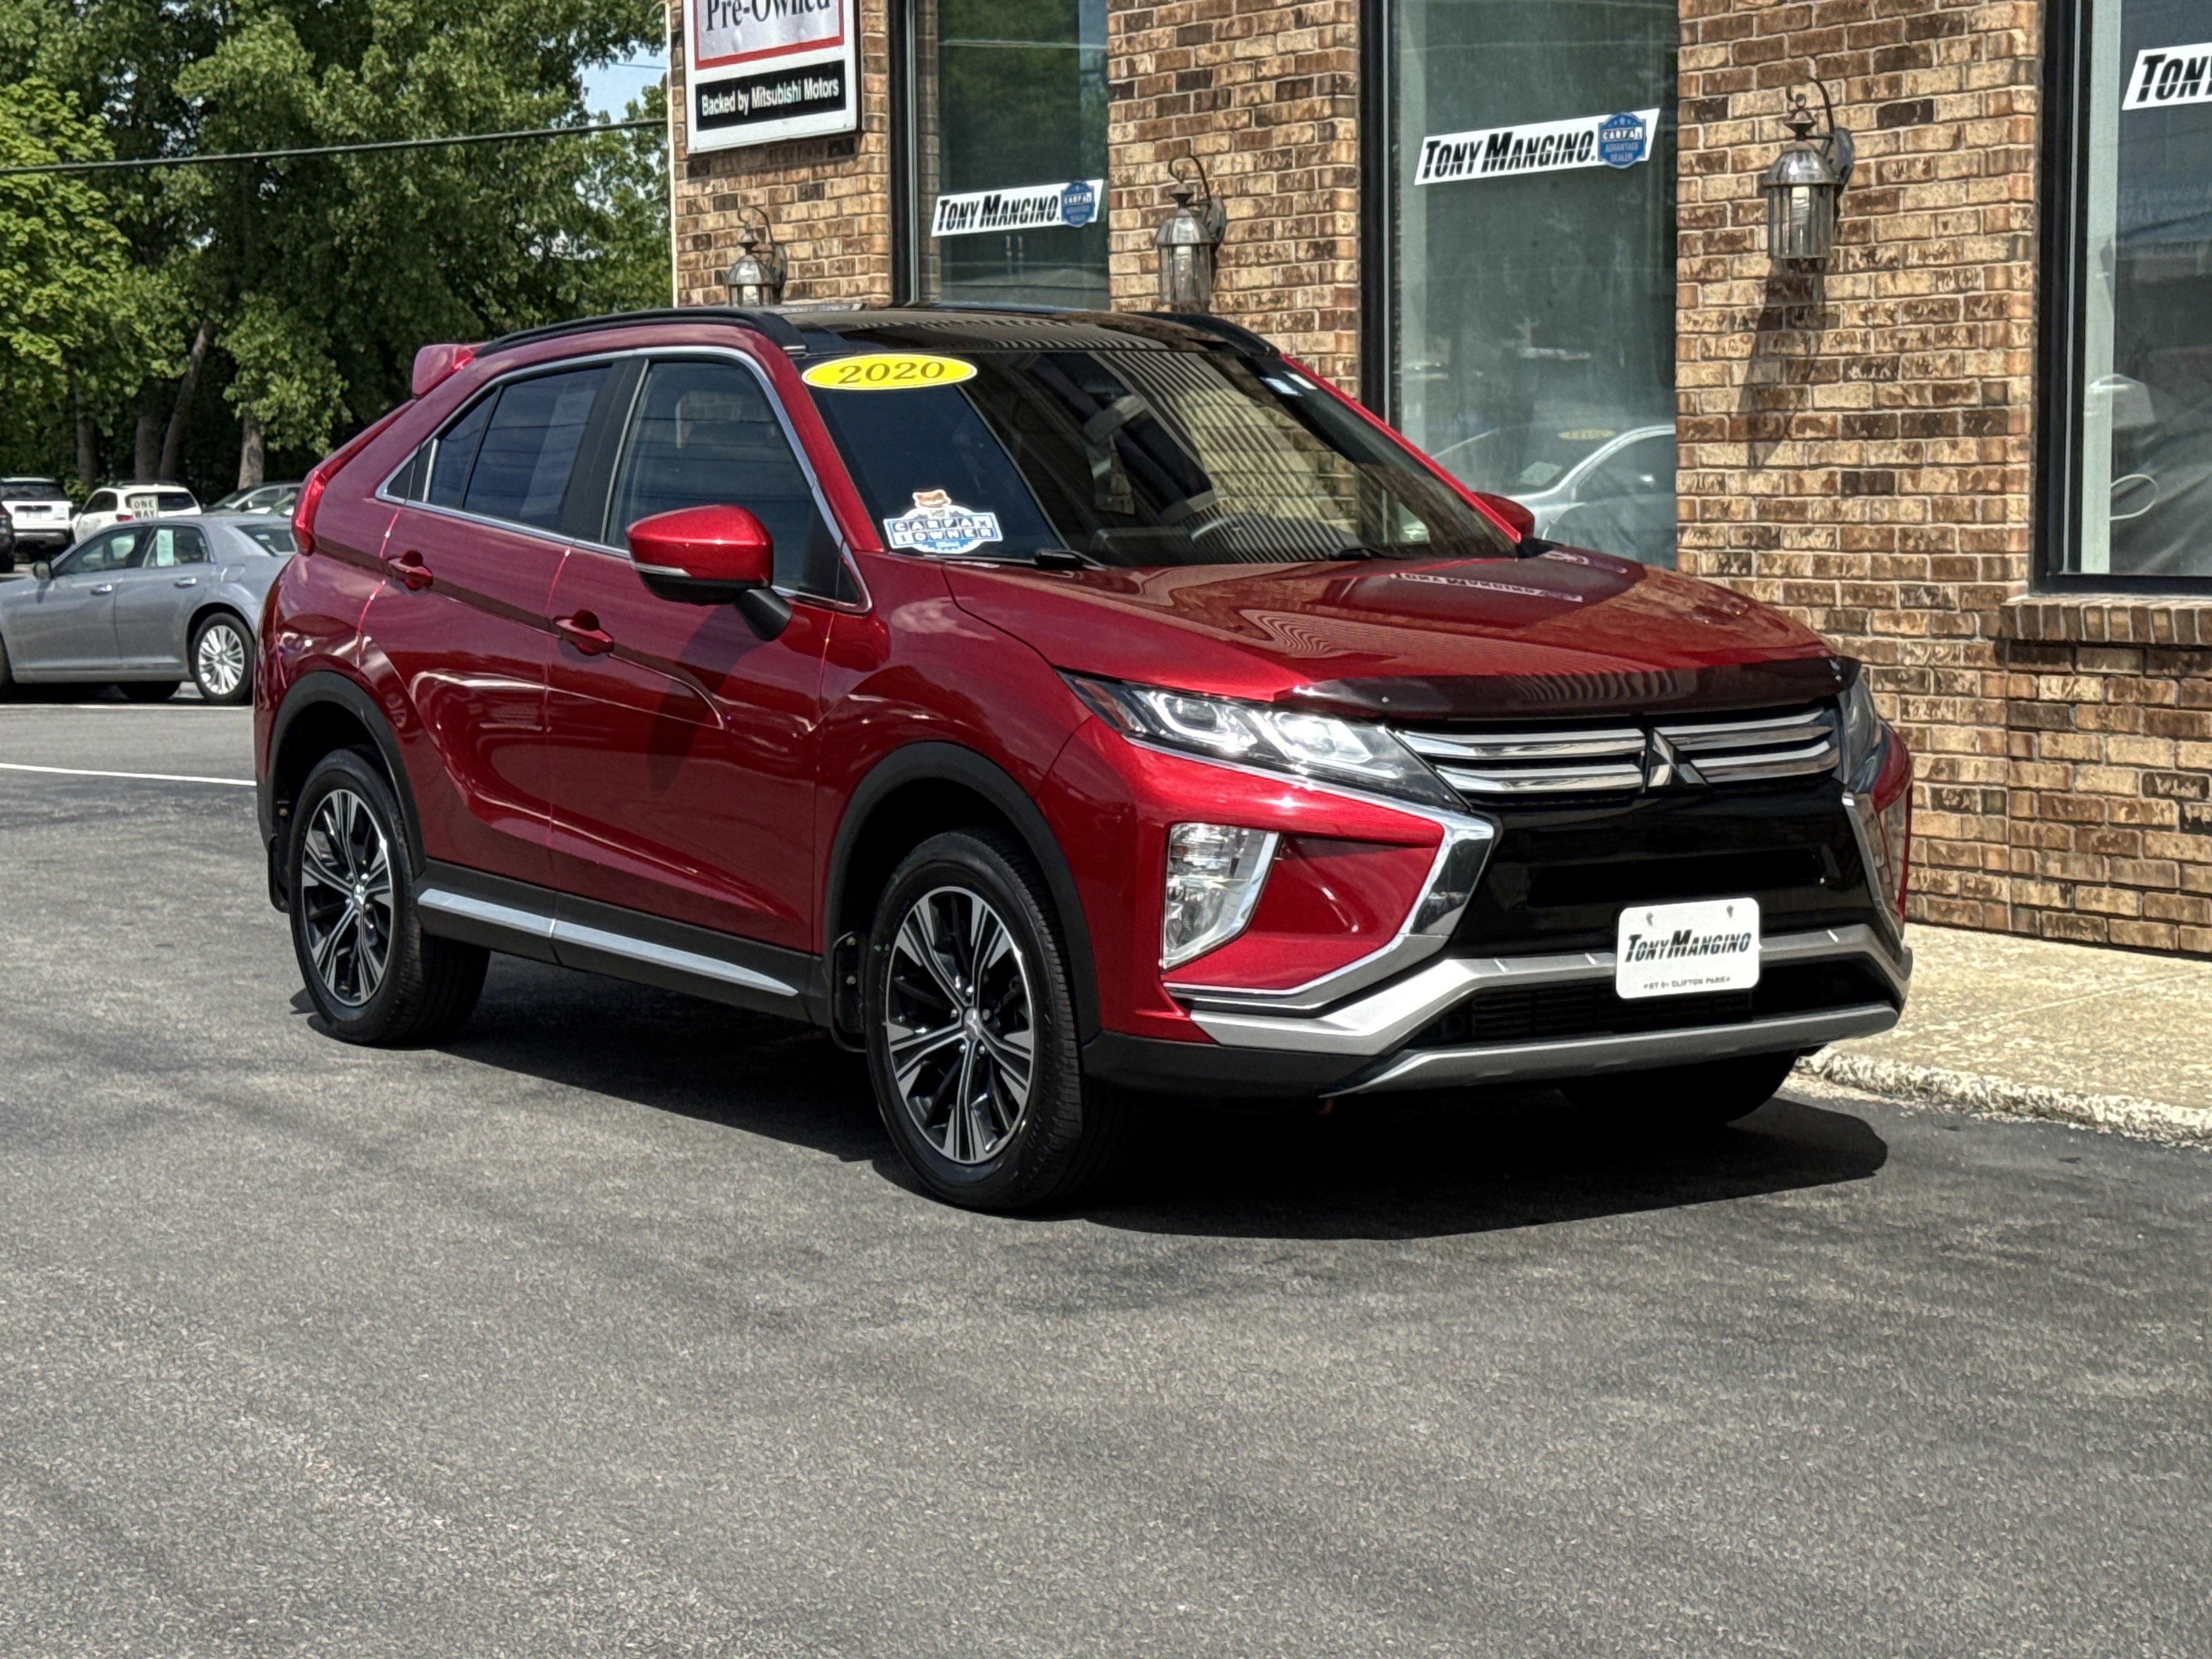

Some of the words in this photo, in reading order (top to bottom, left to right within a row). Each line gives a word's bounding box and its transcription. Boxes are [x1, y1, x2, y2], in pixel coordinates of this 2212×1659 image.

[702, 89, 735, 116] Backed
[738, 89, 749, 116] by
[752, 80, 802, 109] Mitsubishi
[804, 77, 839, 100] Motors
[1423, 140, 1483, 179] TONY
[937, 199, 980, 231] TONY
[838, 362, 945, 384] 2020
[134, 499, 154, 509] ONE
[893, 518, 989, 532] CARFAX
[913, 529, 992, 541] OWNER
[1624, 934, 1669, 963] TONY
[1667, 929, 1752, 958] MANGINO
